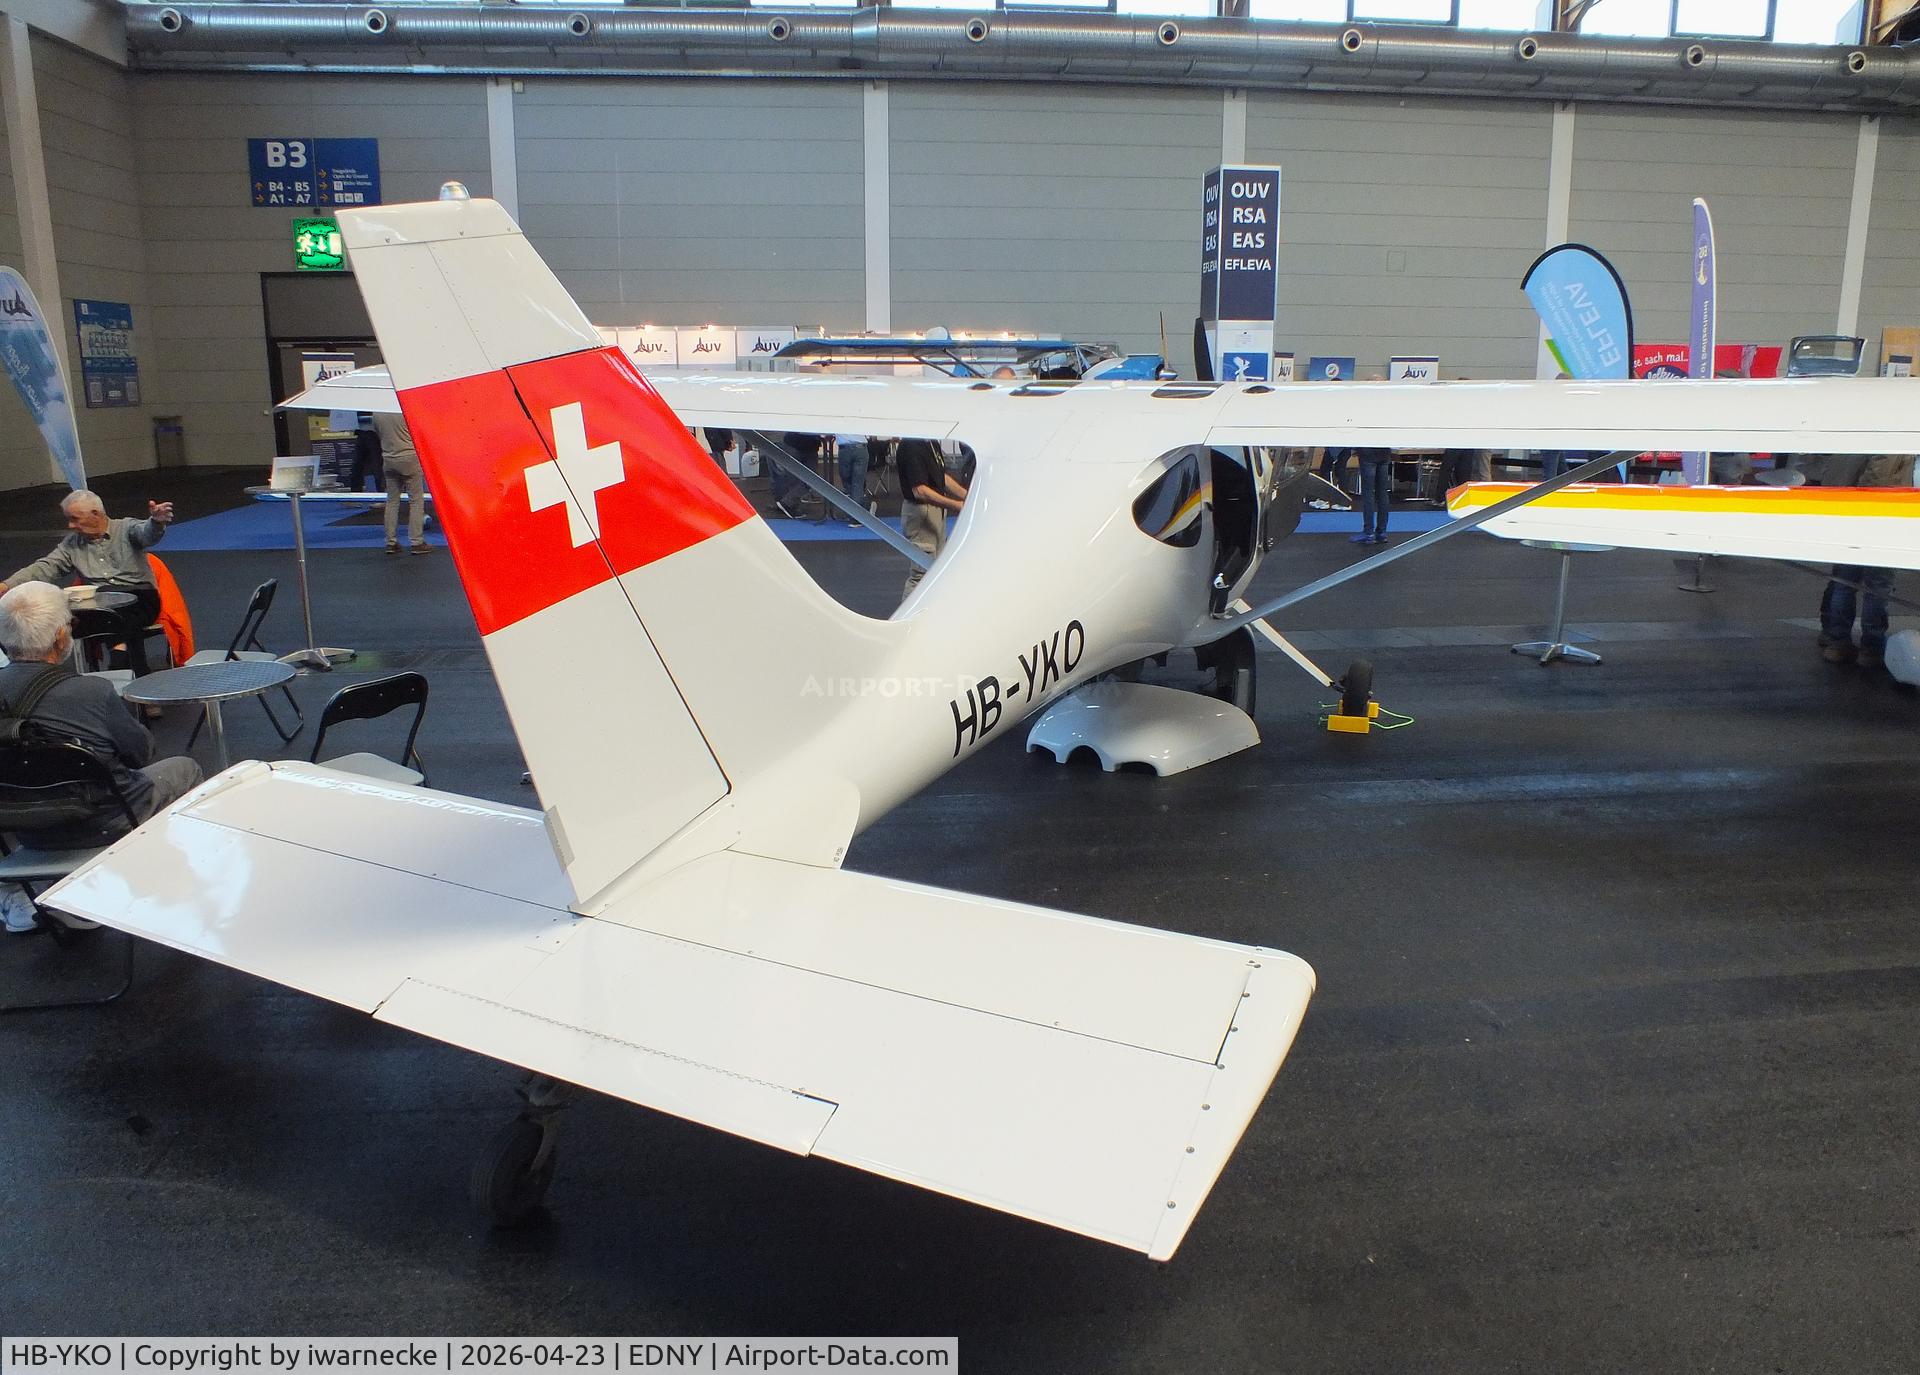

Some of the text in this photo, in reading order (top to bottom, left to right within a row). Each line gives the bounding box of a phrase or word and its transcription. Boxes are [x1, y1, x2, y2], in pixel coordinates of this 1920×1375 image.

[266, 141, 307, 168] B3
[268, 182, 284, 192] B4
[294, 182, 310, 192] B5
[1206, 184, 1219, 203] OUV
[1231, 182, 1270, 199] OUV
[269, 194, 285, 204] A1
[296, 194, 311, 204] A7
[1206, 209, 1217, 228] RSA
[1232, 207, 1266, 224] RSA
[1205, 234, 1217, 252] EAS
[1232, 232, 1265, 249] EAS
[1202, 260, 1218, 274] EFLEVA
[1224, 259, 1272, 271] EFLEVA
[1644, 351, 1663, 365] sach
[950, 619, 1085, 758] HB-YKO
